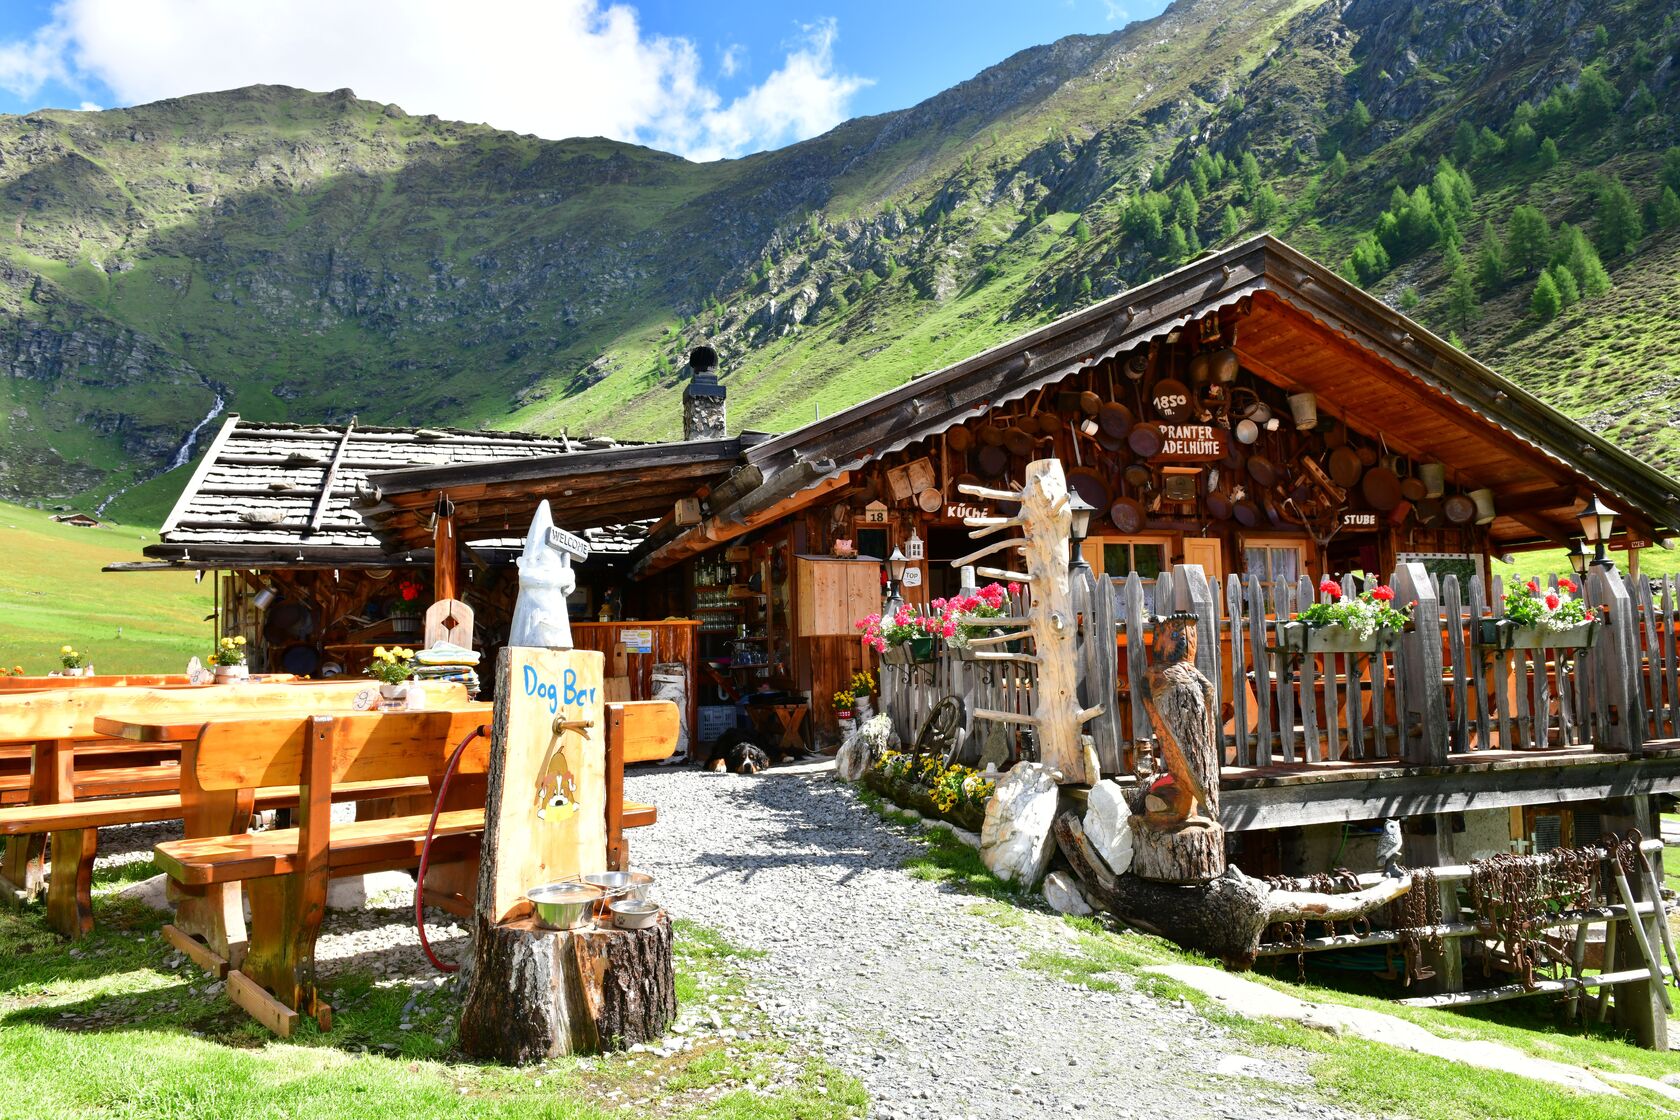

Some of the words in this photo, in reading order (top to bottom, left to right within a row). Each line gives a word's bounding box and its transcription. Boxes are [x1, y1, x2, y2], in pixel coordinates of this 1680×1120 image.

[1153, 394, 1187, 410] 1850
[1159, 424, 1214, 440] PRANTER
[1161, 439, 1220, 455] ADELHÜTTE
[870, 512, 884, 522] 18
[1343, 514, 1376, 525] STUBE
[551, 528, 588, 555] WELCOME
[1631, 540, 1645, 548] WC
[523, 664, 558, 714] Dog
[563, 668, 596, 707] Bar
[357, 691, 369, 709] 9
